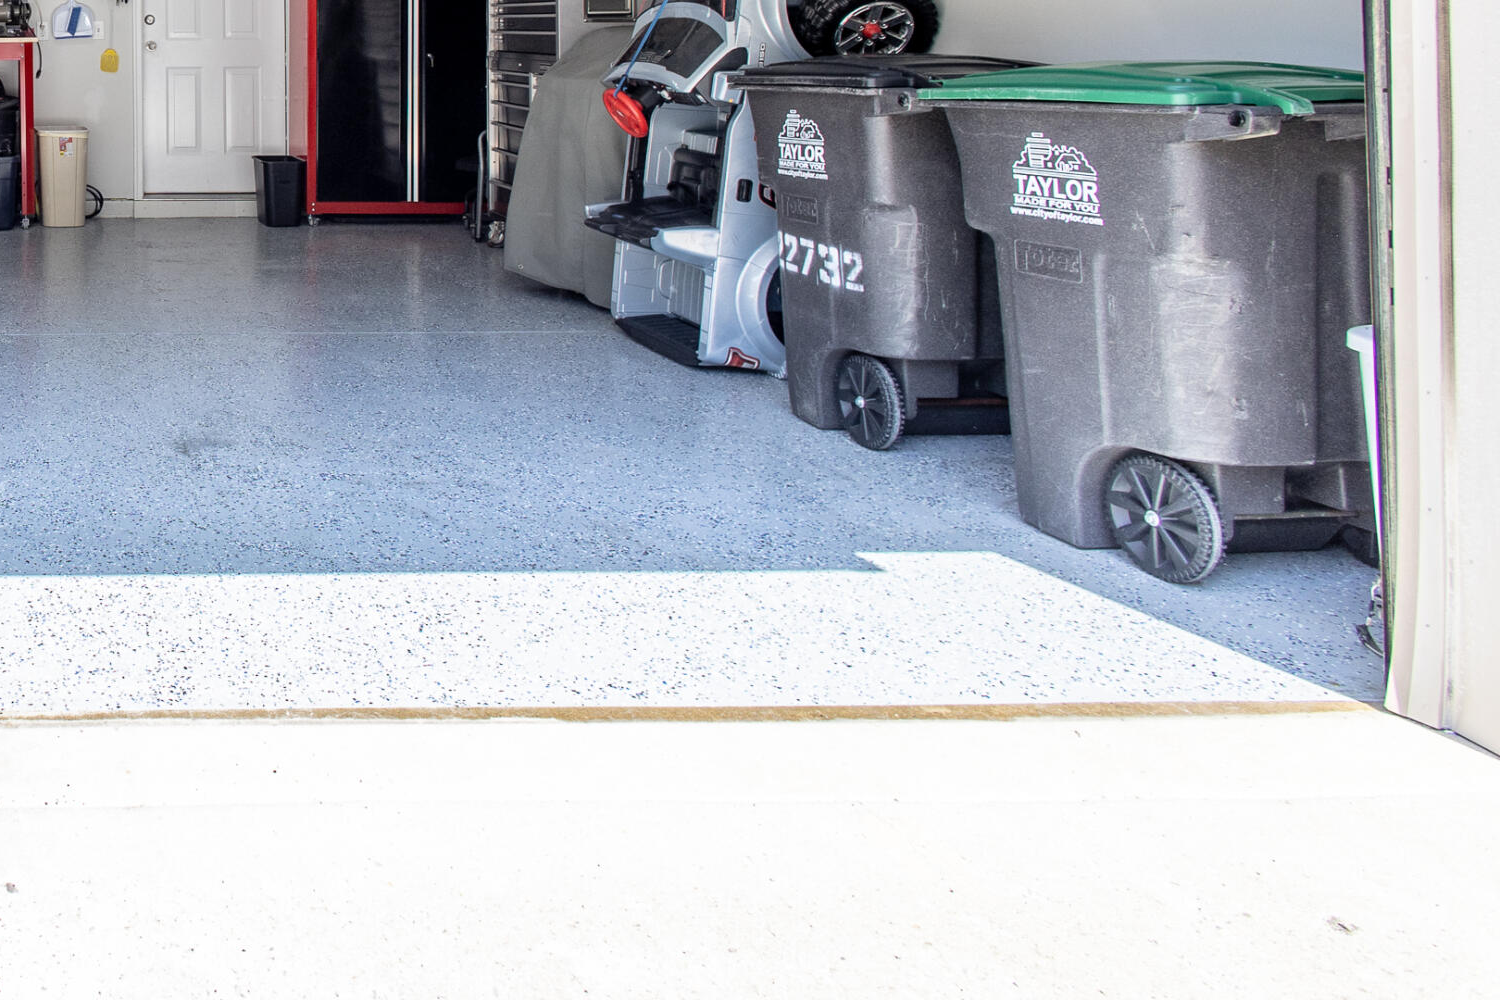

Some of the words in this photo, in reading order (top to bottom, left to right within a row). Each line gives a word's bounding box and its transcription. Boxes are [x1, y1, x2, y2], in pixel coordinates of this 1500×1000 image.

[777, 143, 826, 163] TAYLOR
[779, 160, 794, 168] MADE
[795, 161, 810, 170] FOR
[810, 162, 827, 171] YOU
[1013, 173, 1100, 203] TAYLOR
[1014, 194, 1047, 206] MADE
[1048, 198, 1073, 210] FOR
[1073, 202, 1100, 214] YOU
[1010, 206, 1104, 226] www.cityoftaylor.com
